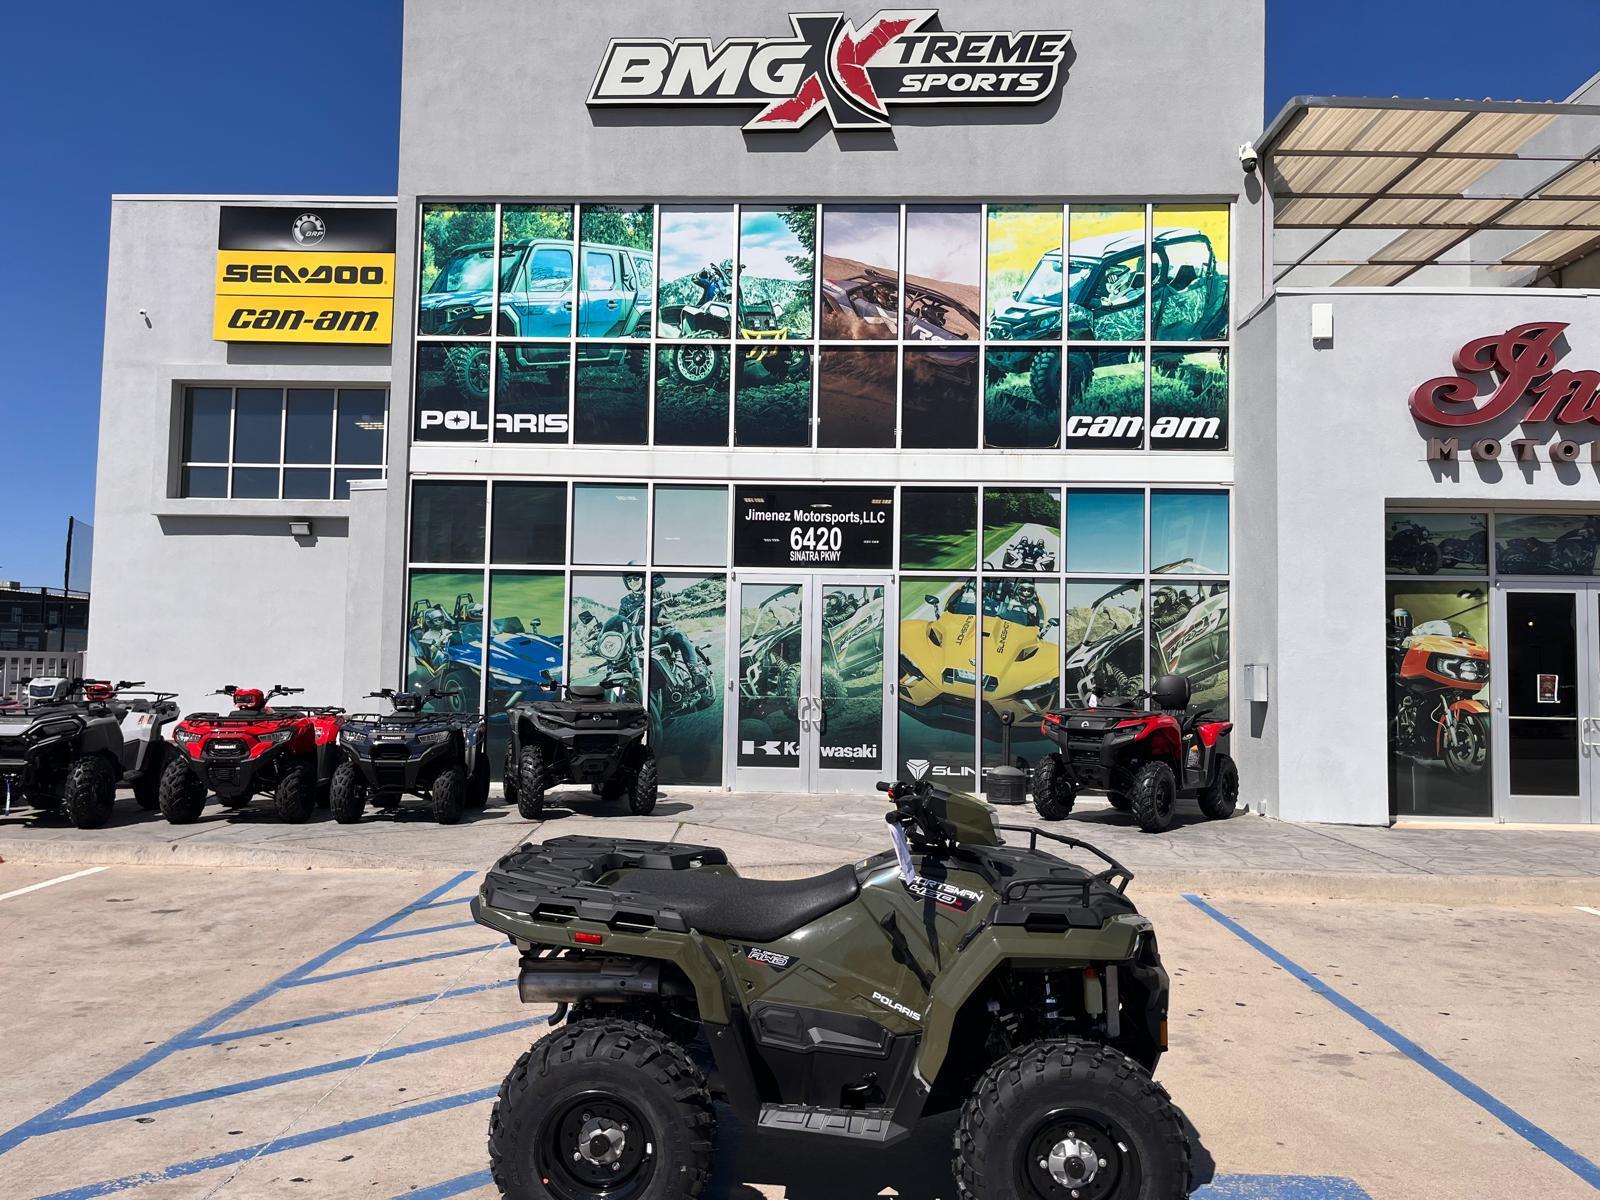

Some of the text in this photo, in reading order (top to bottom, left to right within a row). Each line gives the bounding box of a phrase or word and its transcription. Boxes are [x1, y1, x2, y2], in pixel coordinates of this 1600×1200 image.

[598, 42, 812, 96] BMG
[900, 73, 1043, 92] SPORTS
[228, 309, 379, 331] can-am
[420, 410, 568, 433] POLARIS
[1067, 415, 1220, 440] canam
[1427, 437, 1600, 463] MOTO
[745, 509, 791, 522] Jimenez
[790, 526, 842, 551] 6420
[790, 551, 841, 562] SINATRA PKWY
[872, 991, 921, 1021] POLARIS
